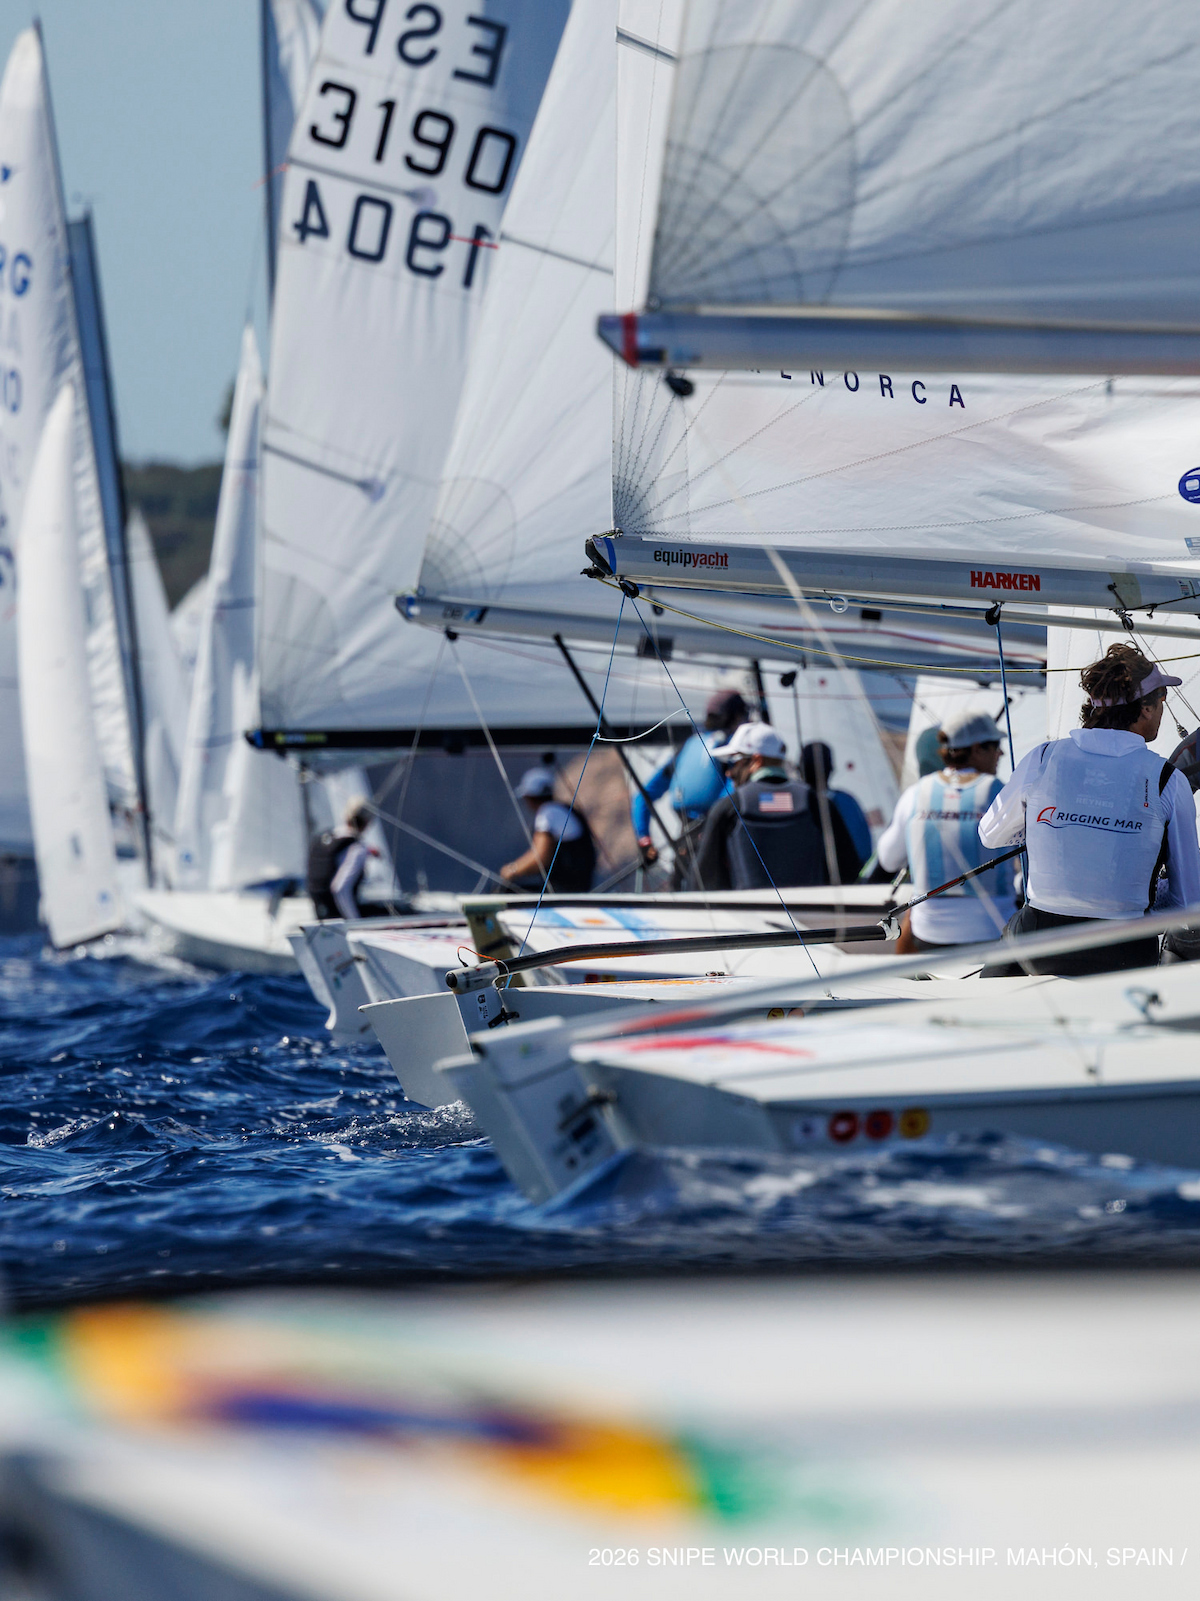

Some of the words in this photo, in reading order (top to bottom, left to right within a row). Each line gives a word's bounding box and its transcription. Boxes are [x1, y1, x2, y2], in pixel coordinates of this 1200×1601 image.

[970, 570, 1041, 591] HARKEN
[1056, 812, 1110, 826] RIGGING
[1114, 819, 1143, 830] MAR
